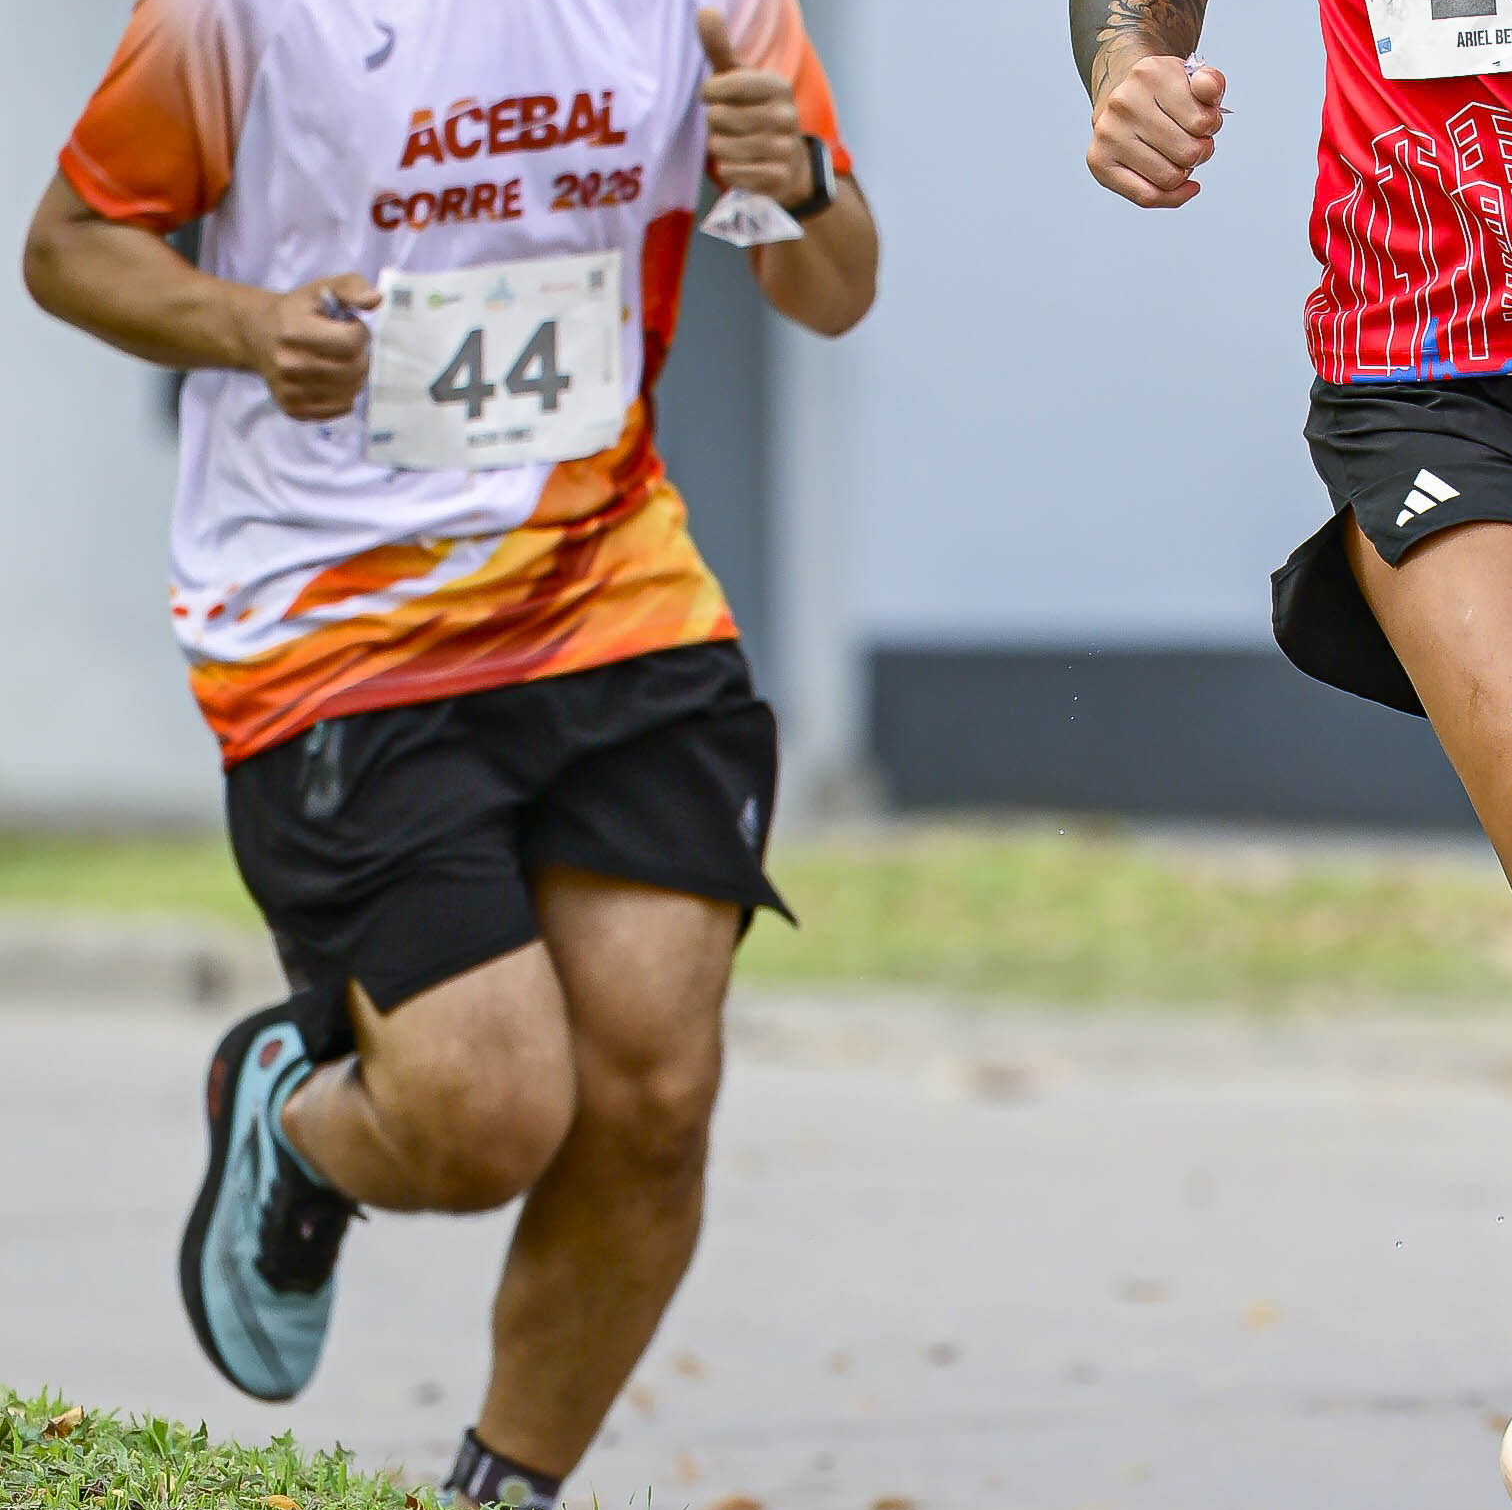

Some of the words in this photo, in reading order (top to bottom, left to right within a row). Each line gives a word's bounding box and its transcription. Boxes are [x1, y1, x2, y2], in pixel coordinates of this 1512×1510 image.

[1457, 30, 1492, 47] ARIEL
[401, 91, 626, 169] ACEBAL
[371, 178, 522, 230] CORRE
[429, 320, 571, 419] 44
